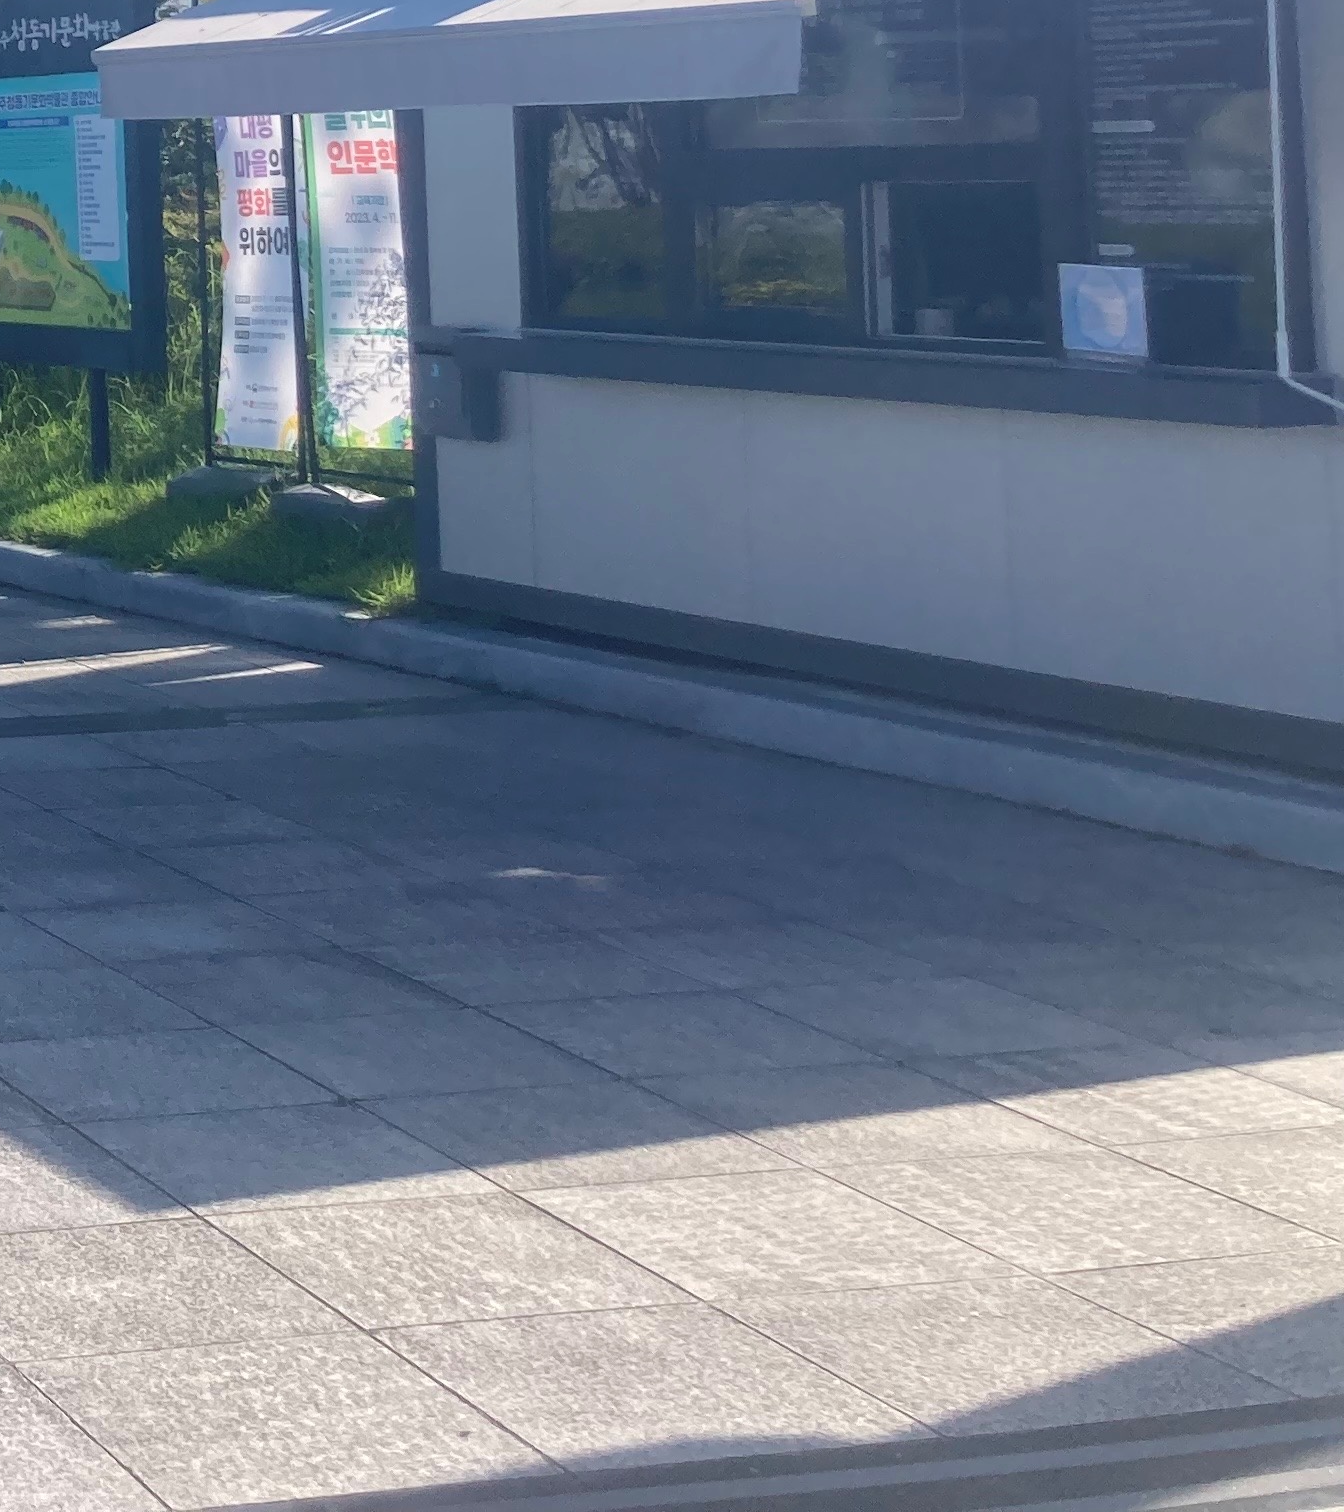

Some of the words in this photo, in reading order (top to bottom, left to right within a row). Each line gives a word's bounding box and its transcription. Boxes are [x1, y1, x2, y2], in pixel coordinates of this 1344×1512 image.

[326, 139, 399, 175] 인문학
[236, 187, 289, 217] 평화를
[238, 226, 291, 255] 위하여
